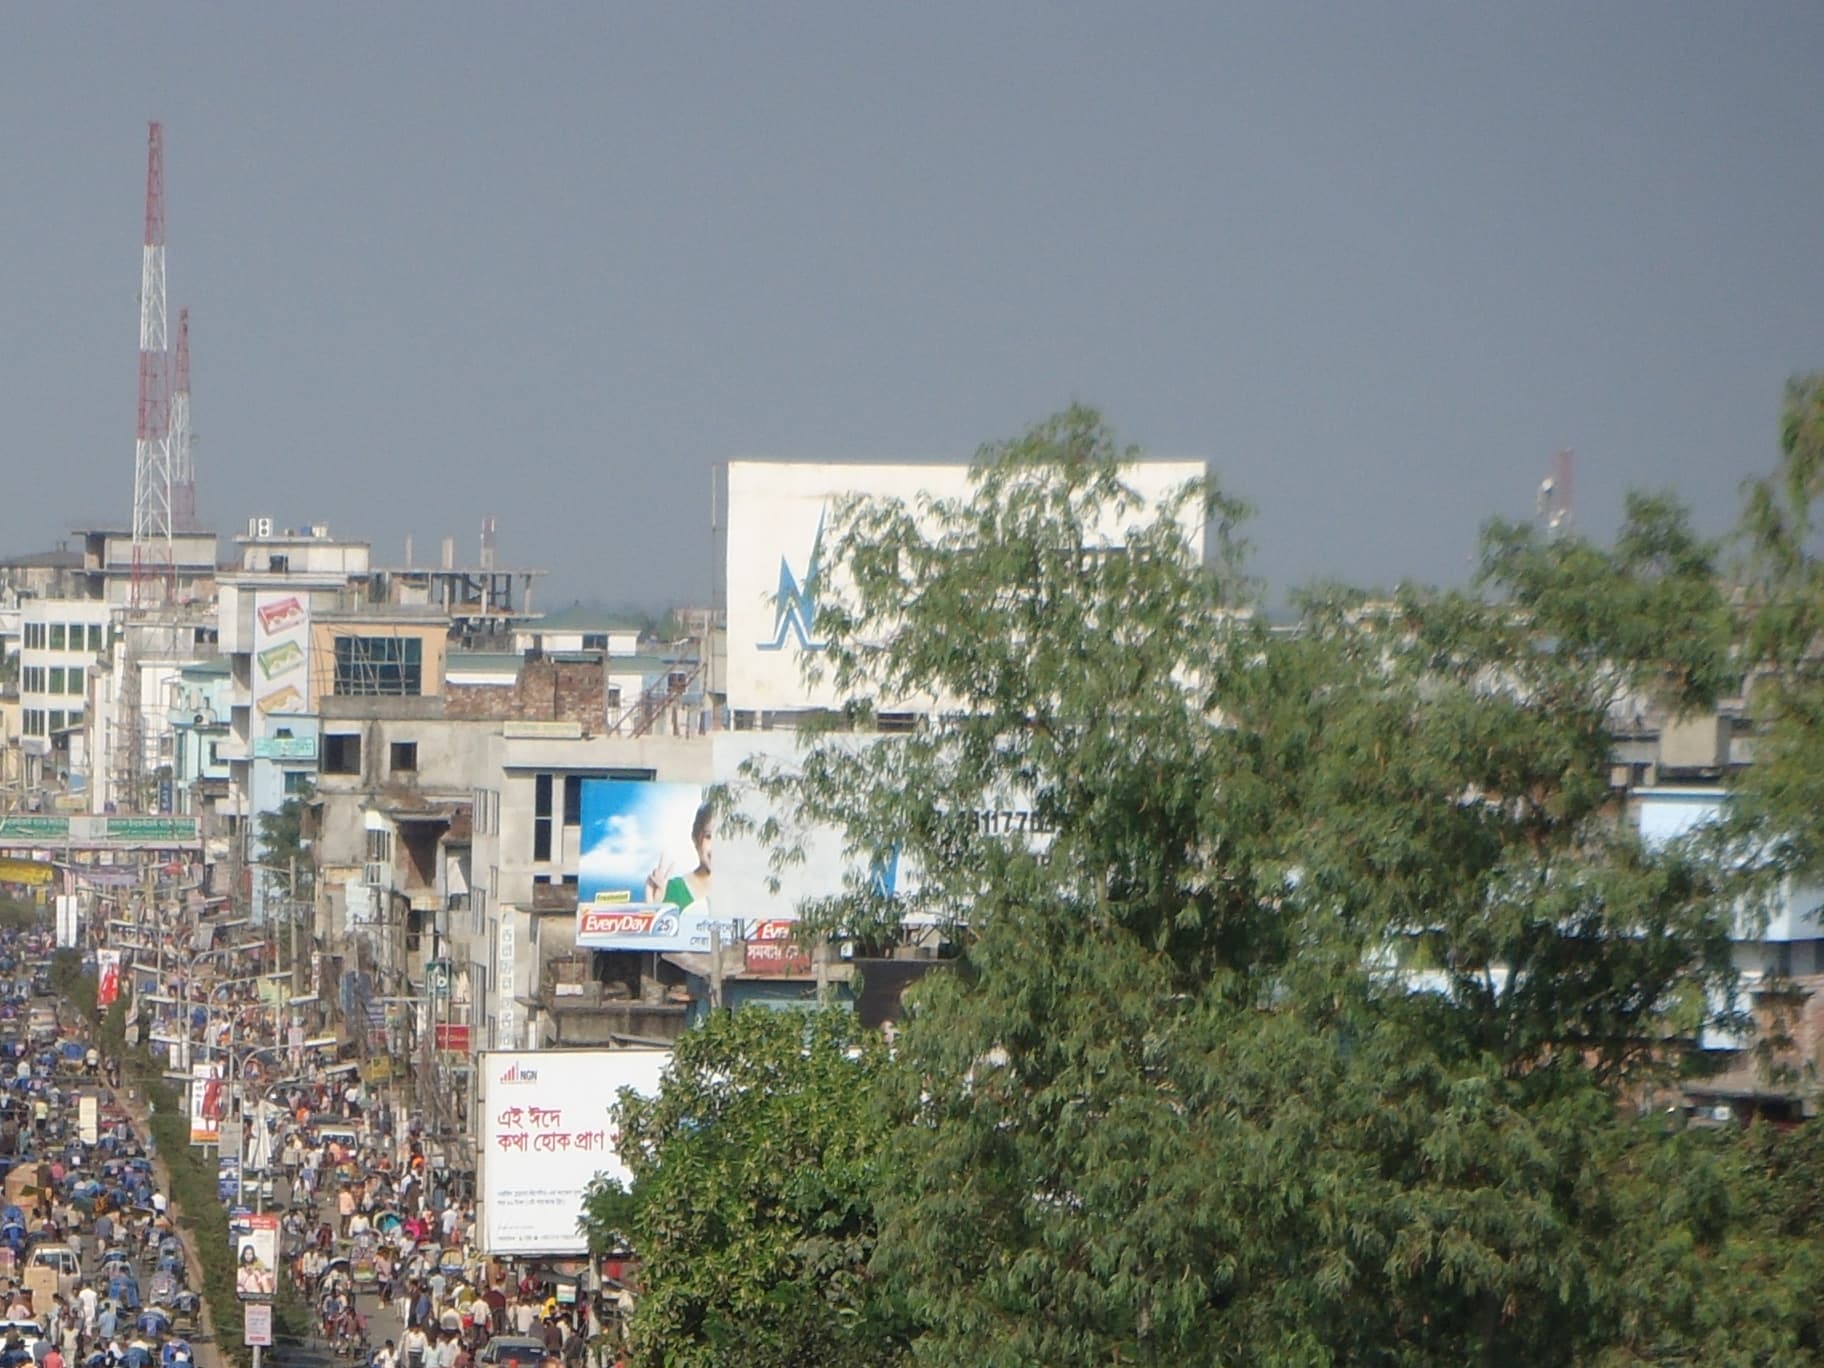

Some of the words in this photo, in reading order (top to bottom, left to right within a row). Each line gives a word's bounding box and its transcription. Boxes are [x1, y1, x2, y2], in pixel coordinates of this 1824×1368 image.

[585, 915, 648, 932] EveryDay
[497, 1106, 523, 1129] এই
[528, 1105, 561, 1128] ঈদে
[496, 1132, 529, 1152] কথা
[534, 1132, 571, 1152] হোক
[574, 1130, 605, 1151] প্রাণ
